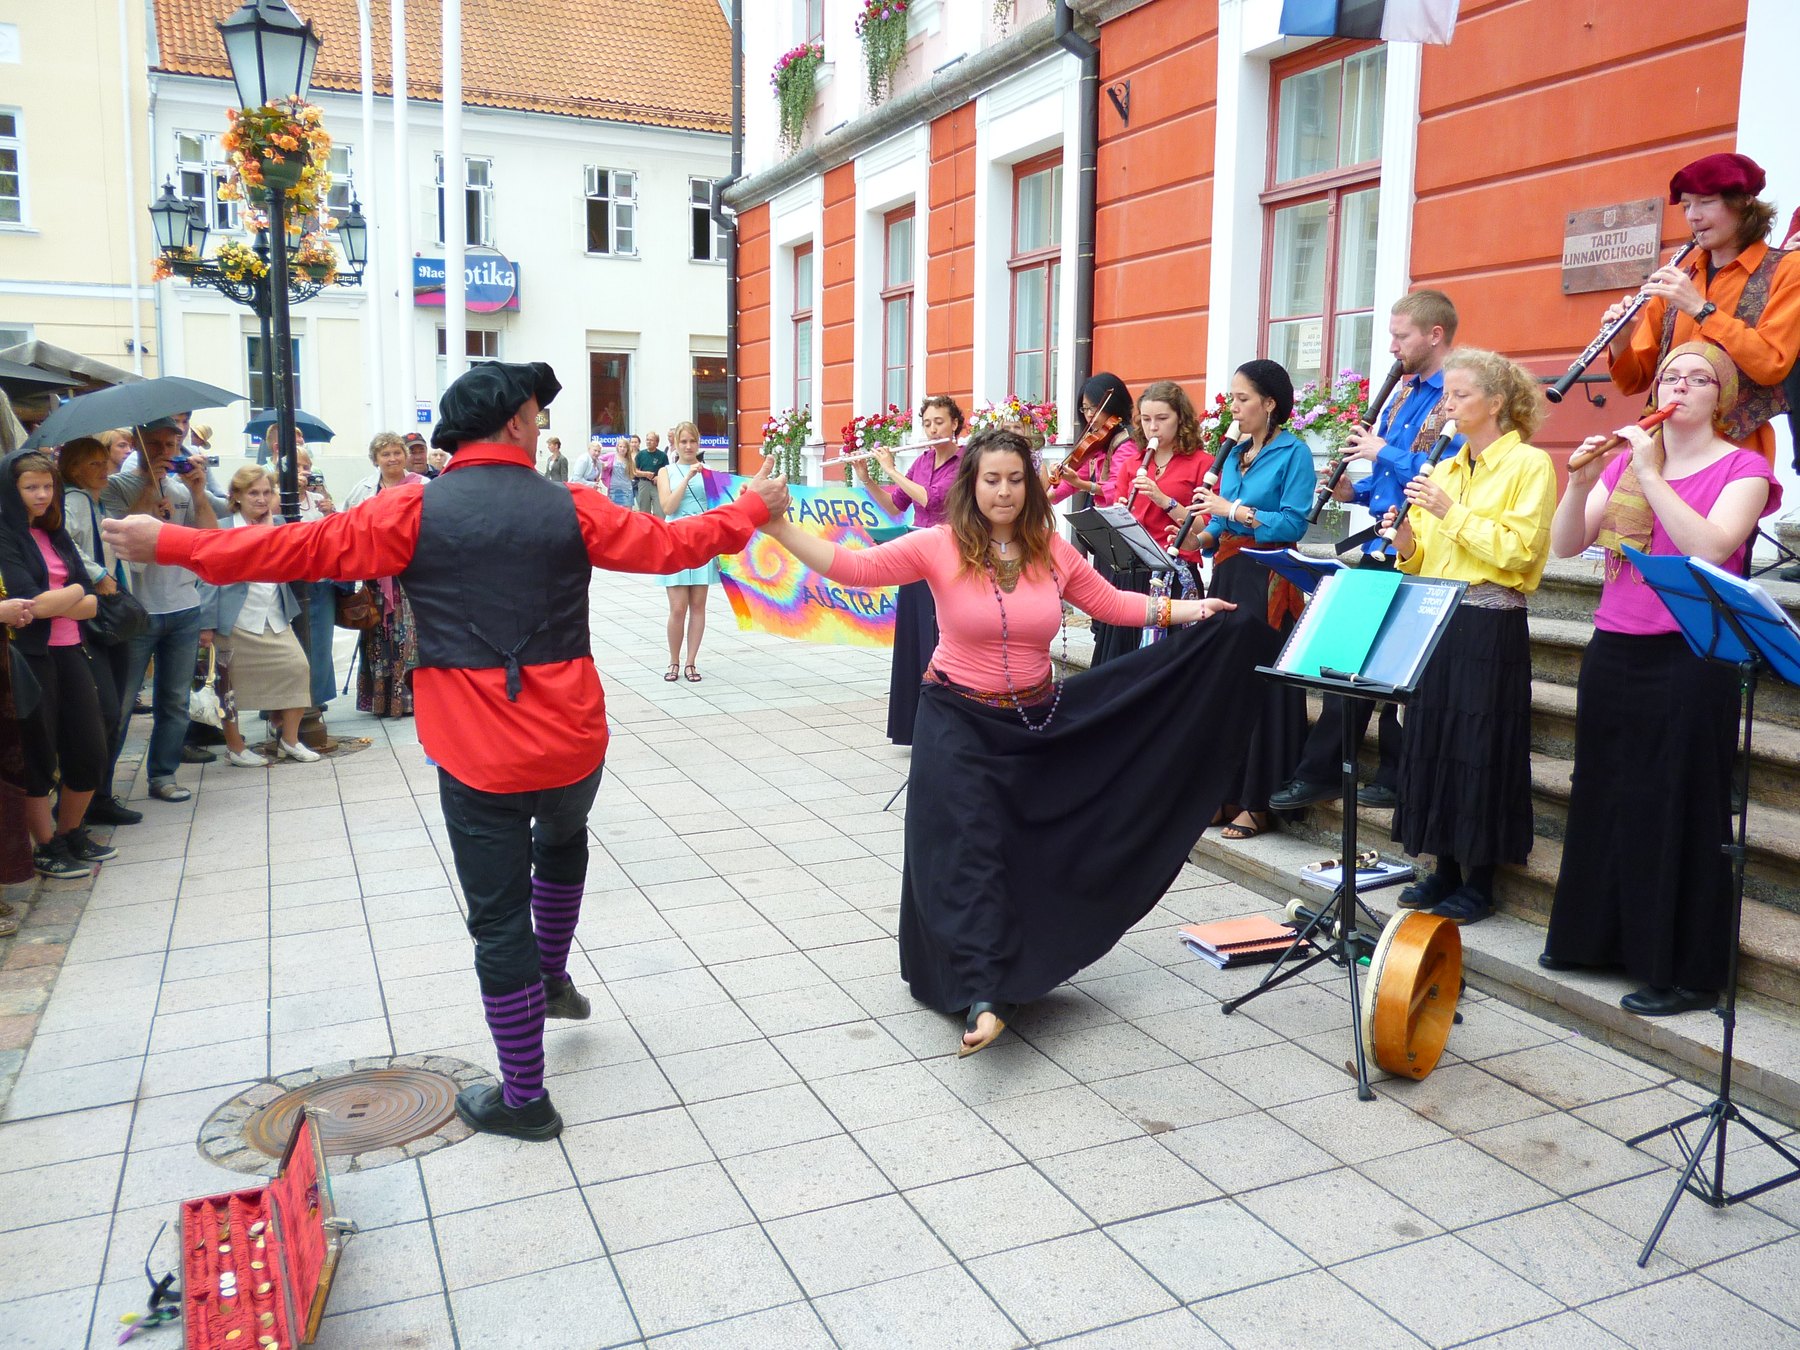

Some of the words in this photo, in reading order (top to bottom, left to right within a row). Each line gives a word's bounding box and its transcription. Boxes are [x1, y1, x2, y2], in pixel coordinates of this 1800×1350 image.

[1591, 231, 1628, 248] TARTU
[1564, 242, 1654, 266] LINNAVOLIKOGU
[464, 261, 515, 290] ptika
[699, 436, 729, 446] aeoptika
[803, 585, 899, 615] AUSTRA
[1422, 597, 1443, 606] STORY
[1417, 605, 1440, 615] SONGS
